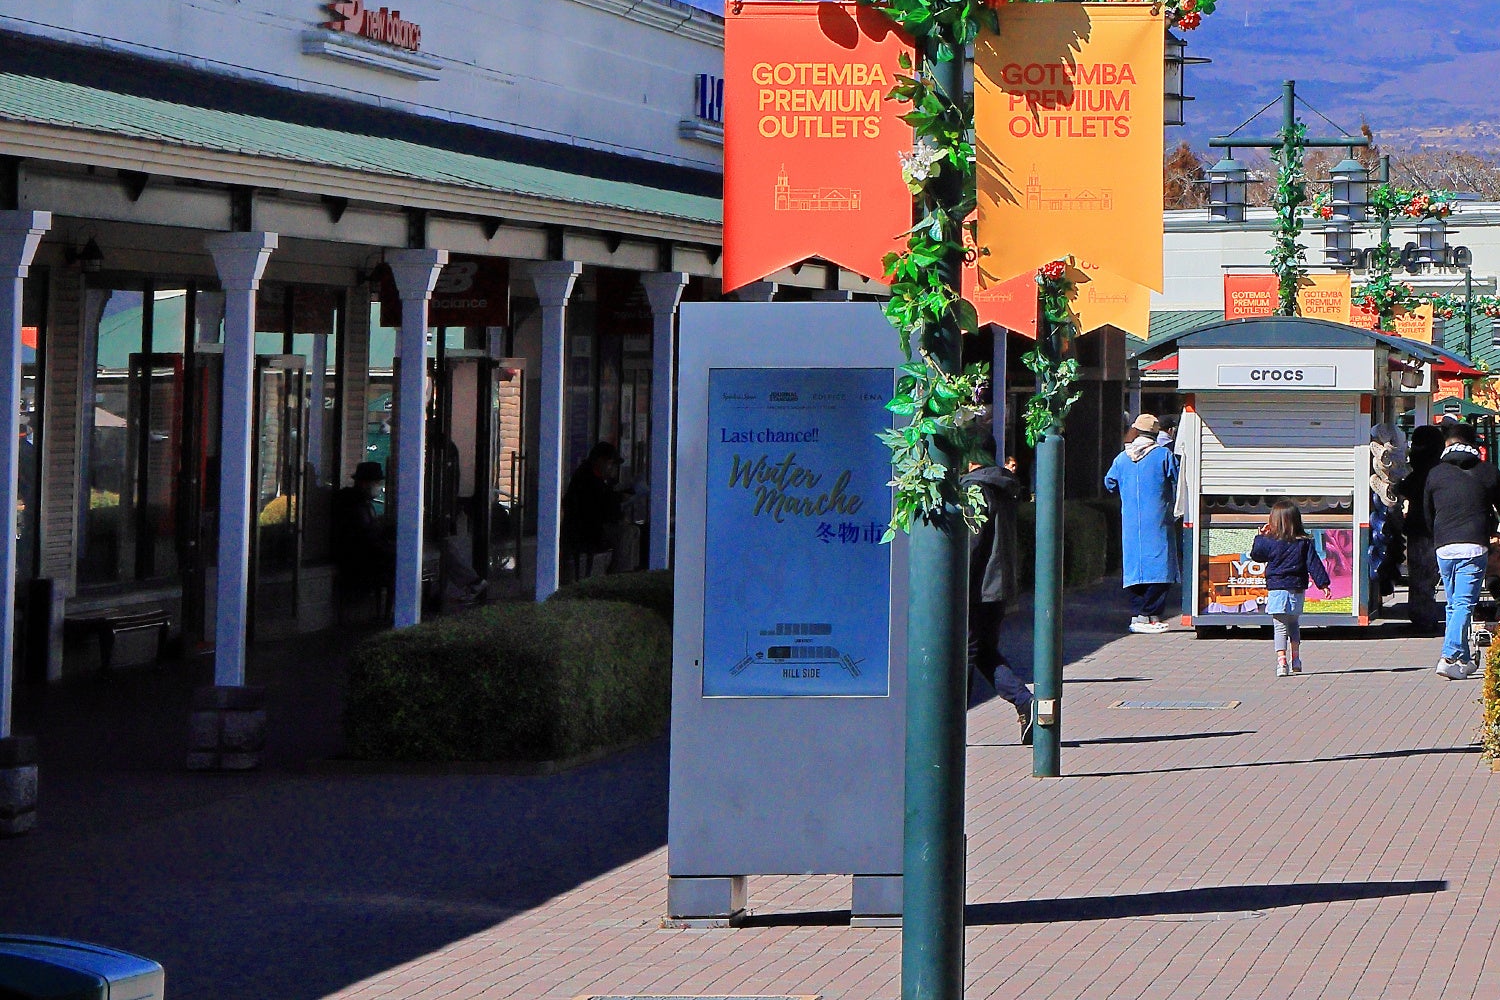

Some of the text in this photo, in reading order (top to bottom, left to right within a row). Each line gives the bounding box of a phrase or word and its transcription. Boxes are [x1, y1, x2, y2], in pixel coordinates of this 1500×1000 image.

[752, 62, 887, 86] GOTEMBA
[1001, 62, 1137, 86] GOTEMBA
[758, 89, 880, 112] PREMIUM
[1008, 89, 1130, 112] PREMIUM
[758, 115, 881, 139] OUTLETS
[1008, 115, 1131, 139] OUTLETS
[1231, 291, 1272, 299] GOTEMBA
[1233, 306, 1270, 314] OUTLETS
[1250, 369, 1304, 381] crocs
[721, 427, 819, 443] Last chance!!
[728, 452, 822, 491] Winter
[753, 470, 864, 523] Marche
[816, 521, 884, 544] 冬物市
[1231, 560, 1268, 575] YO
[782, 668, 820, 678] HILL SIDE
